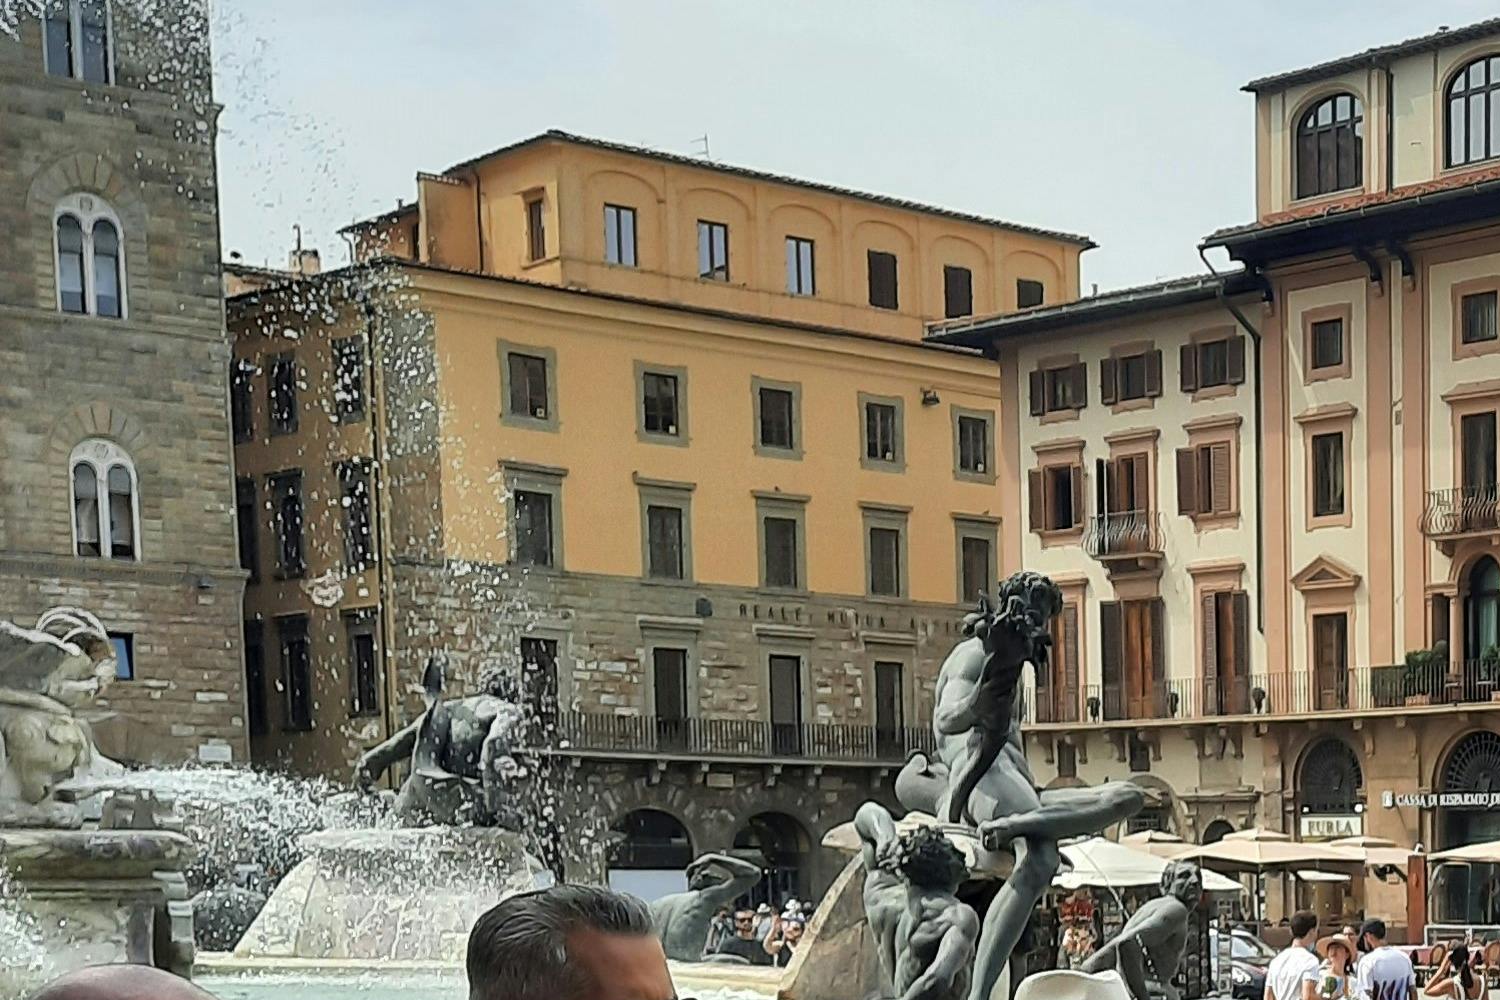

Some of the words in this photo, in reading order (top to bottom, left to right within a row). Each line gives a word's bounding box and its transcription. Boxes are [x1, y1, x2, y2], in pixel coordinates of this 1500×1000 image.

[1396, 793, 1427, 807] CASSA
[1439, 791, 1489, 807] RISPARMIO
[1308, 820, 1353, 836] FURLA
